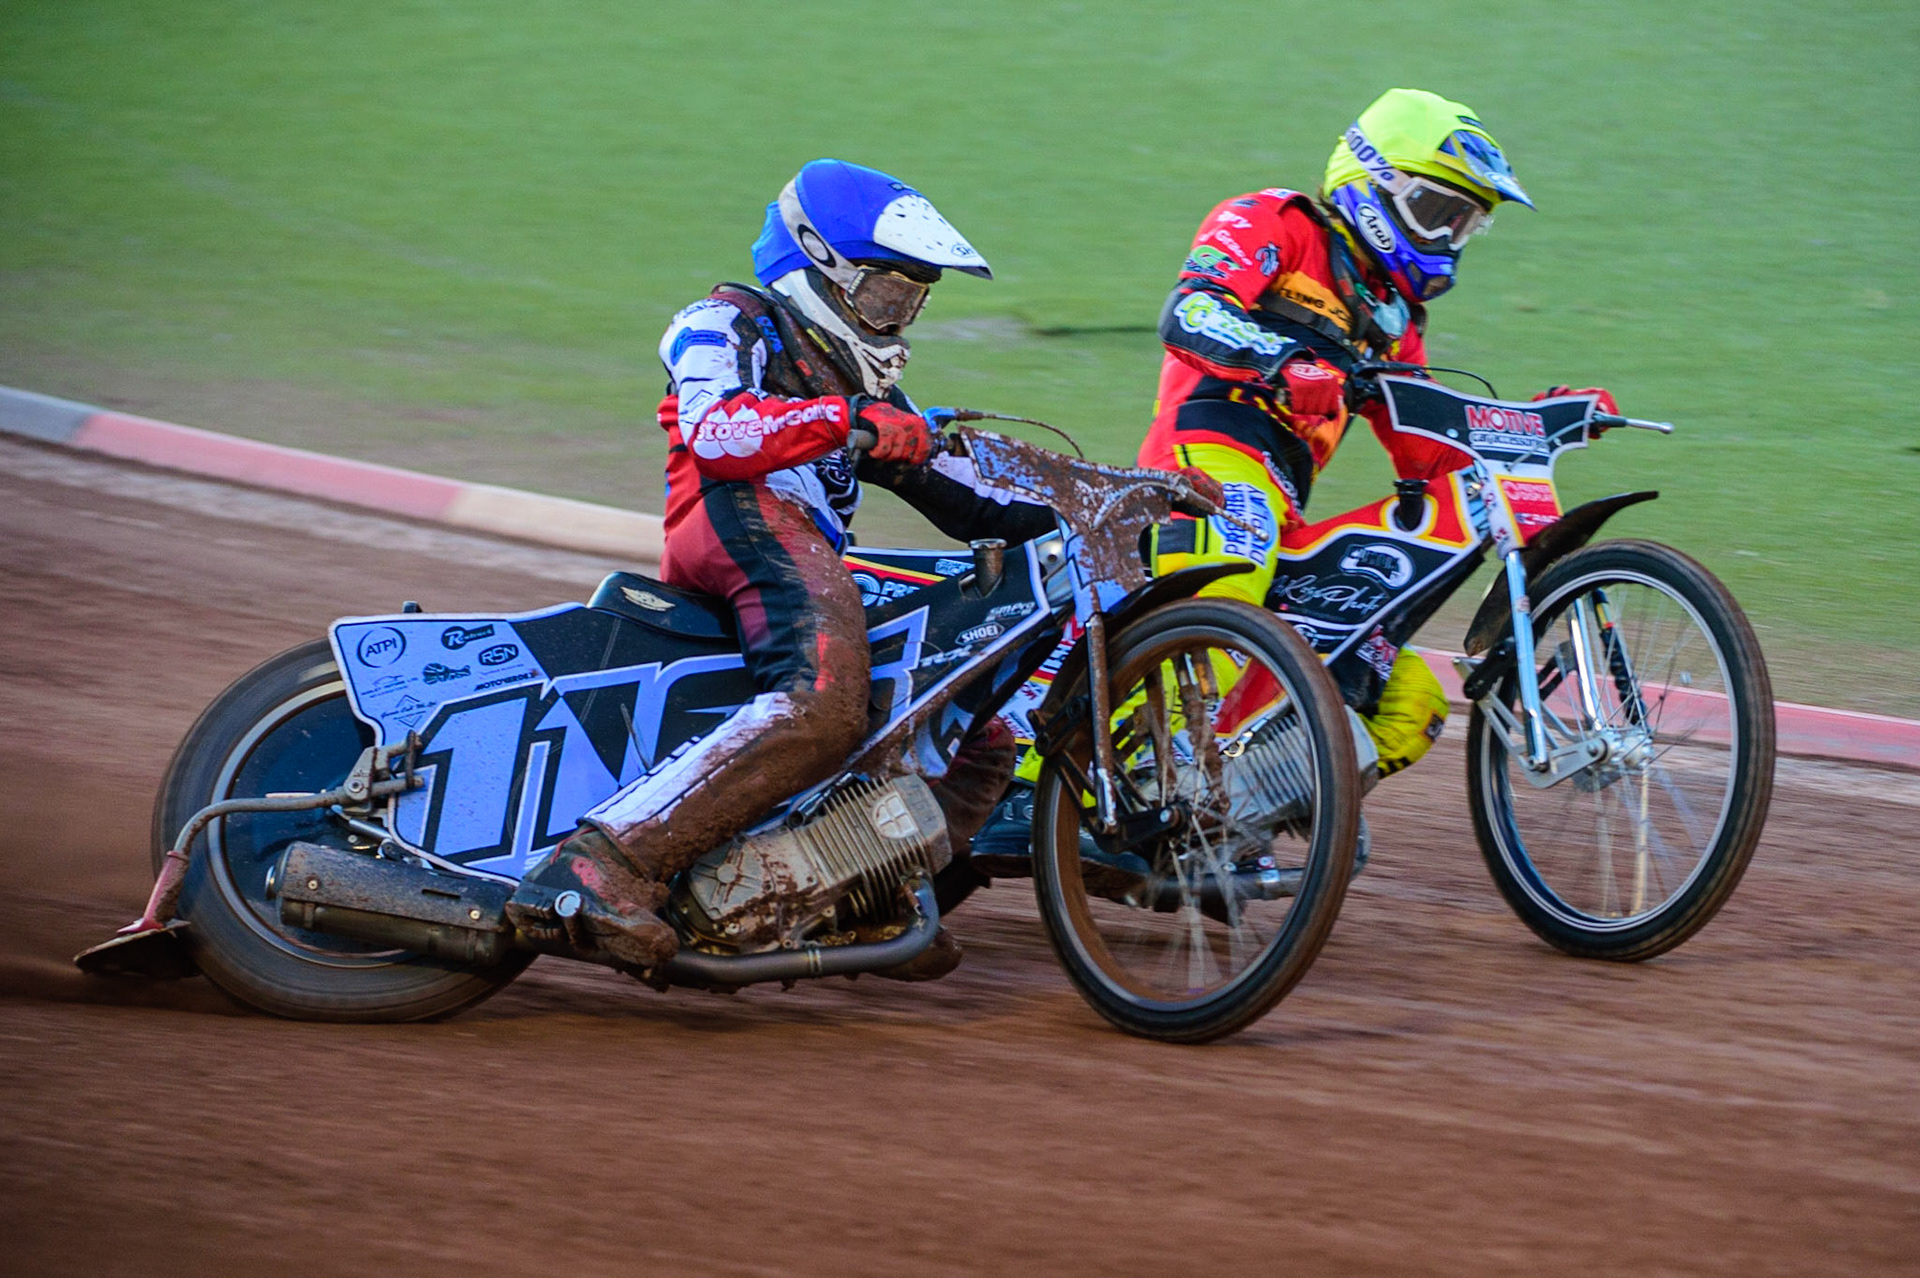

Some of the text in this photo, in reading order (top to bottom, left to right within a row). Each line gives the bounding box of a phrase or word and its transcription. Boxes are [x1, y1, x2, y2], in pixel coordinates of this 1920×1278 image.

[1464, 404, 1547, 438] MOTIVE
[1247, 483, 1269, 567] DIPLAY
[961, 624, 999, 644] SHOEI
[365, 638, 398, 659] ATPI
[481, 646, 517, 664] RSN
